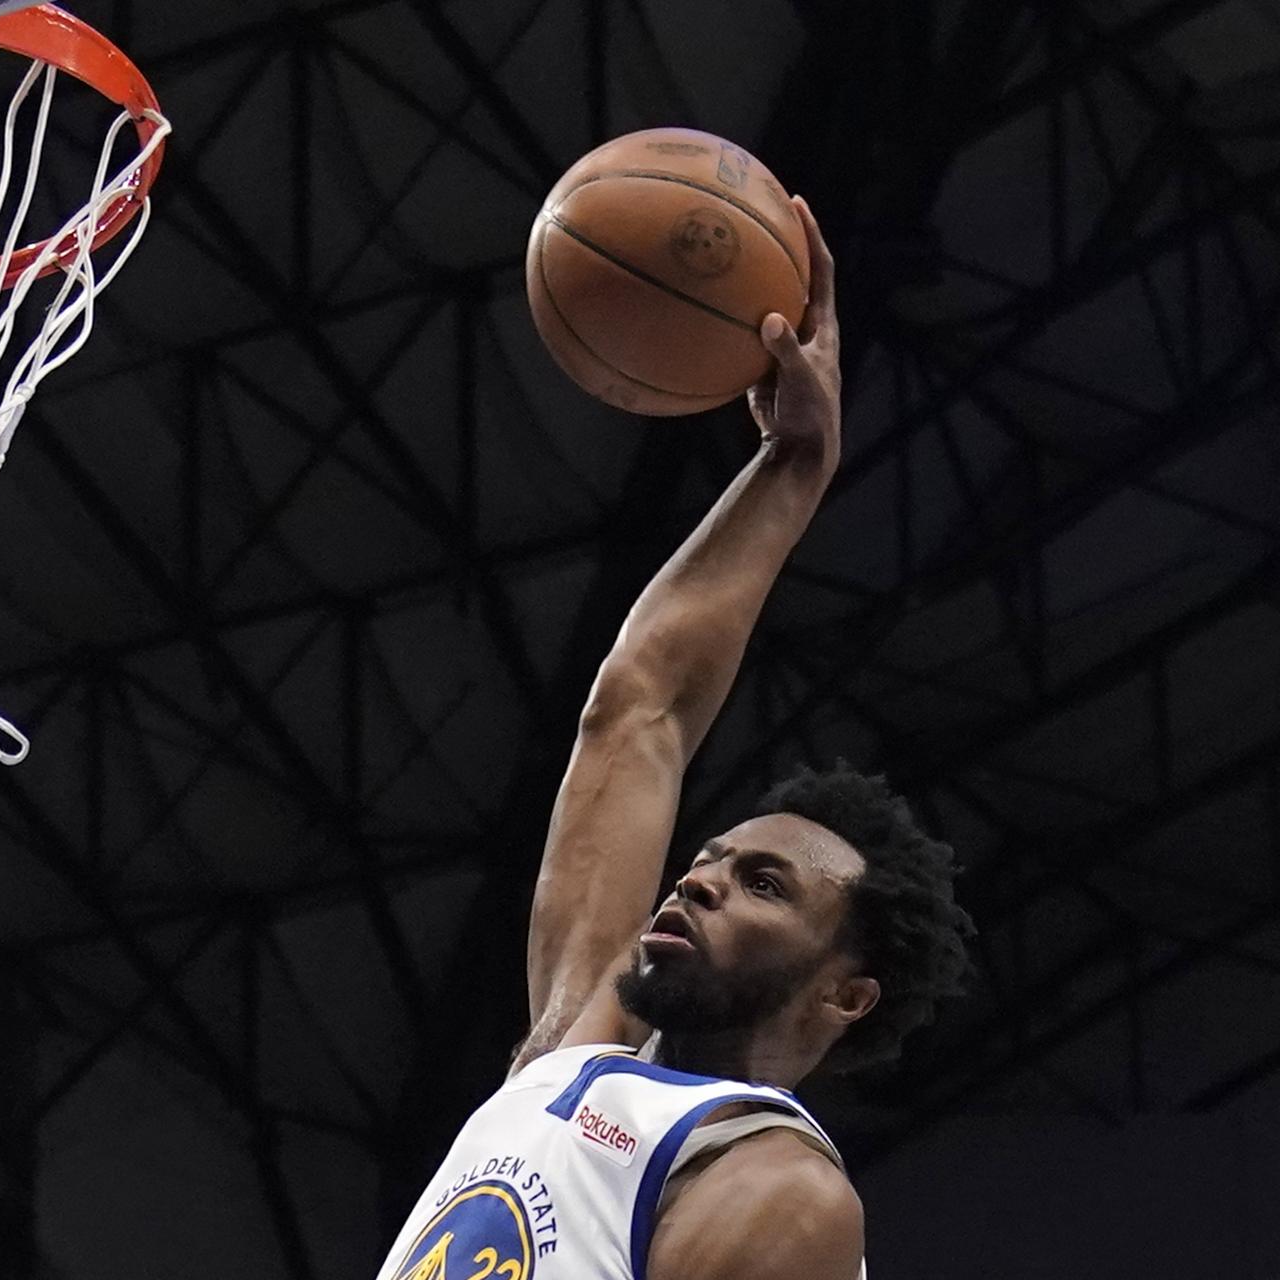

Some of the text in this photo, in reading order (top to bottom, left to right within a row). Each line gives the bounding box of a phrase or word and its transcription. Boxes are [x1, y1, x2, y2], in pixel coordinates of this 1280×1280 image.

[576, 1105, 636, 1156] Rakuten
[436, 1156, 557, 1258] GOLDEN STATE
